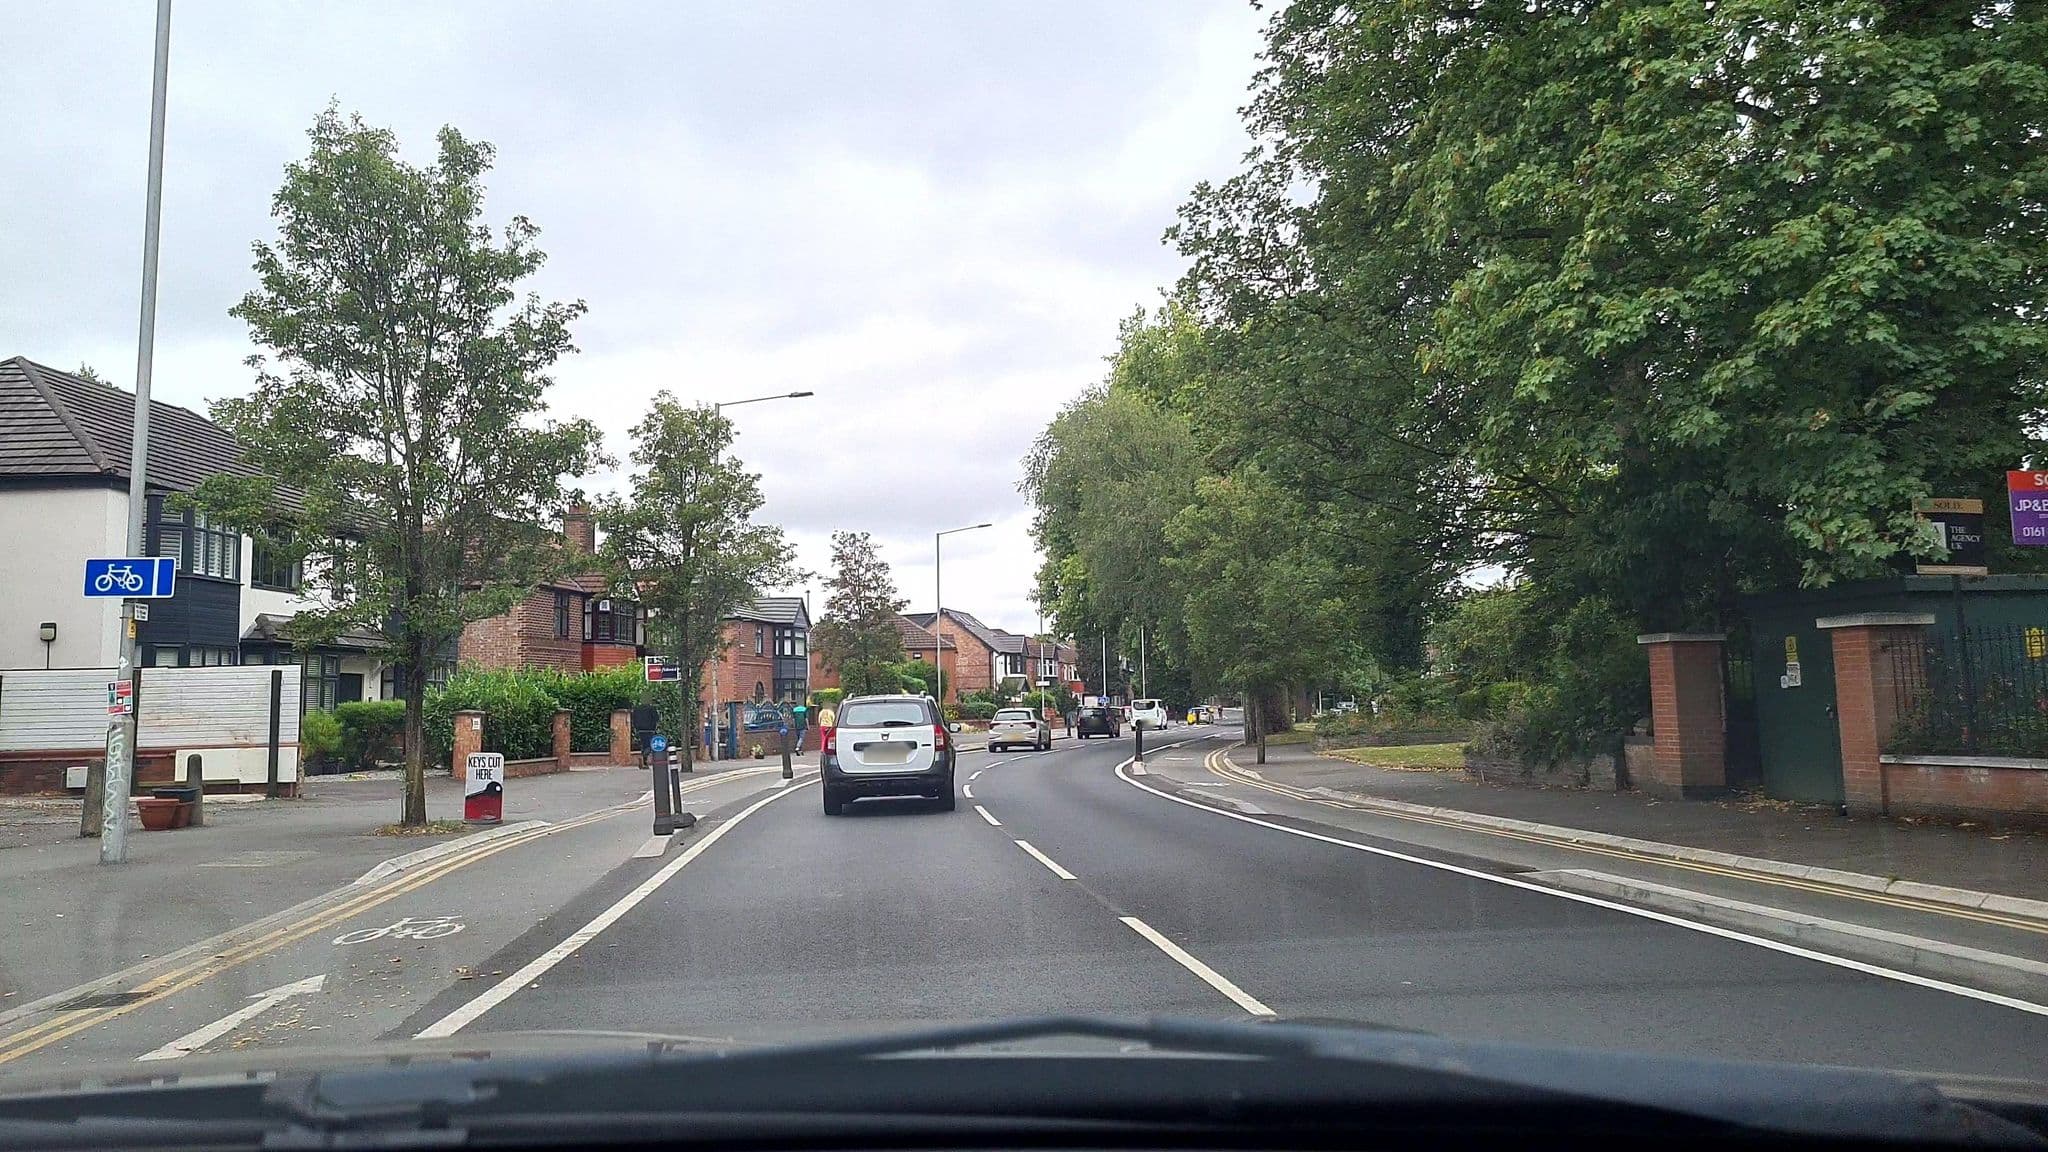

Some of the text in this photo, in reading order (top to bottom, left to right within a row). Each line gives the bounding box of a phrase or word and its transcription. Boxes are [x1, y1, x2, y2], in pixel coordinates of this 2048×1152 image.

[2022, 526, 2046, 537] 0161
[1951, 534, 1981, 542] AGENCY
[468, 756, 502, 768] KEYS CUT
[475, 769, 493, 780] HERE
